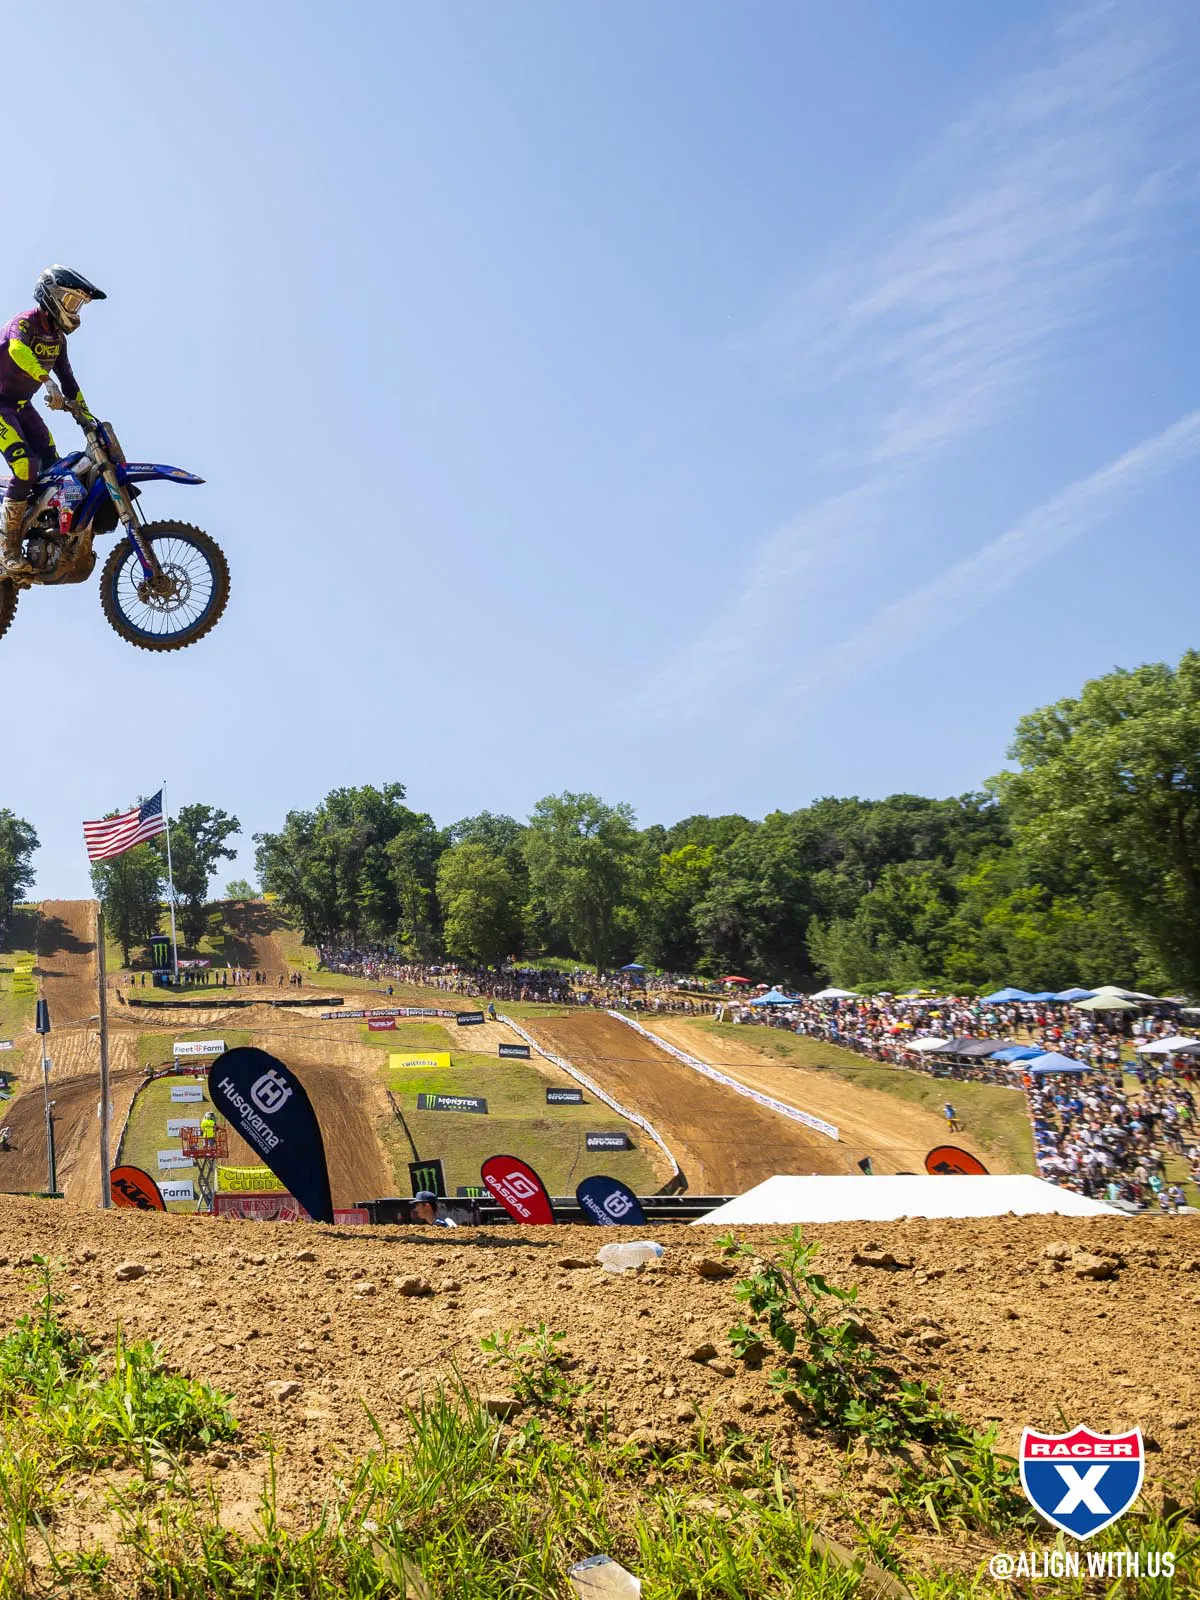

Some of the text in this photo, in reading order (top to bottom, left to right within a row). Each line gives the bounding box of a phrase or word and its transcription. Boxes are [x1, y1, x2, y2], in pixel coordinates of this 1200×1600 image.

[203, 1044, 223, 1052] Farm
[218, 1077, 280, 1148] Husqvarna
[438, 1097, 478, 1107] MONSTER
[240, 1120, 271, 1154] MOTORCYCLES
[163, 1188, 192, 1198] Farm
[485, 1175, 532, 1218] GASGAS
[582, 1194, 617, 1226] Husqva
